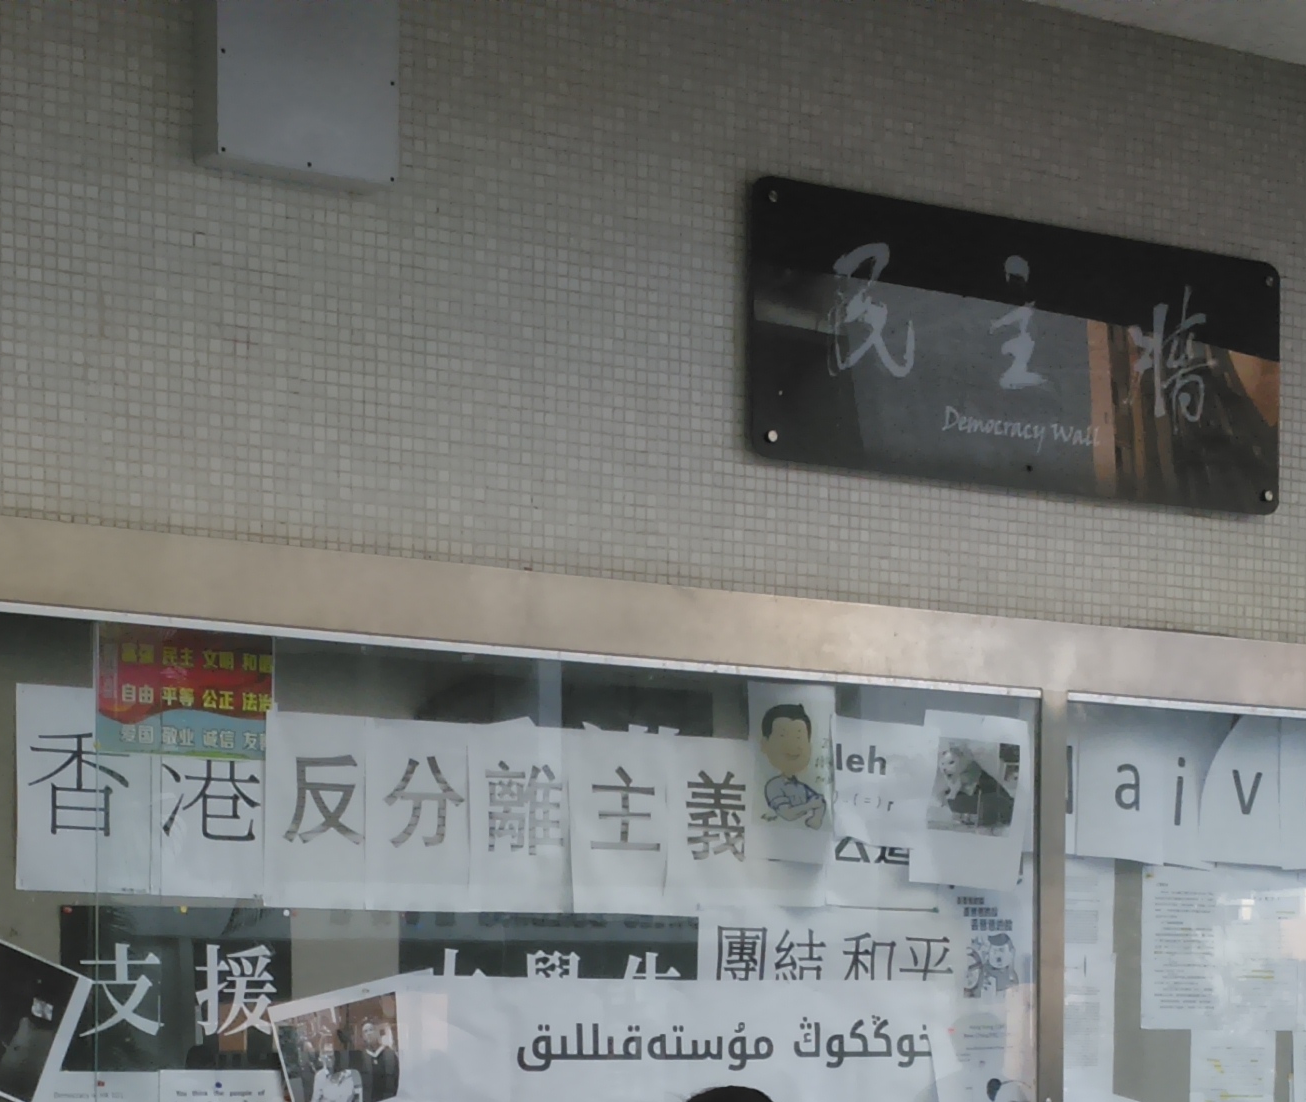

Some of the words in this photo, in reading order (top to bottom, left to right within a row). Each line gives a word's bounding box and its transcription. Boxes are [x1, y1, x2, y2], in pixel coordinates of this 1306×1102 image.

[942, 405, 1045, 454] Democracy
[1051, 423, 1101, 447] Wall
[162, 646, 194, 668] 民主
[202, 650, 234, 670] 文明
[122, 684, 154, 703] 自由
[162, 686, 195, 707] 平等
[202, 689, 234, 710] 公正
[242, 692, 273, 712] 法治
[121, 725, 154, 744] 爱国
[162, 726, 194, 746] 敬业
[203, 730, 235, 748] 诚信
[29, 733, 261, 841] 香港
[283, 755, 746, 863] 反分離主義
[716, 925, 953, 981] 團結和平
[79, 943, 277, 1037] 支援
